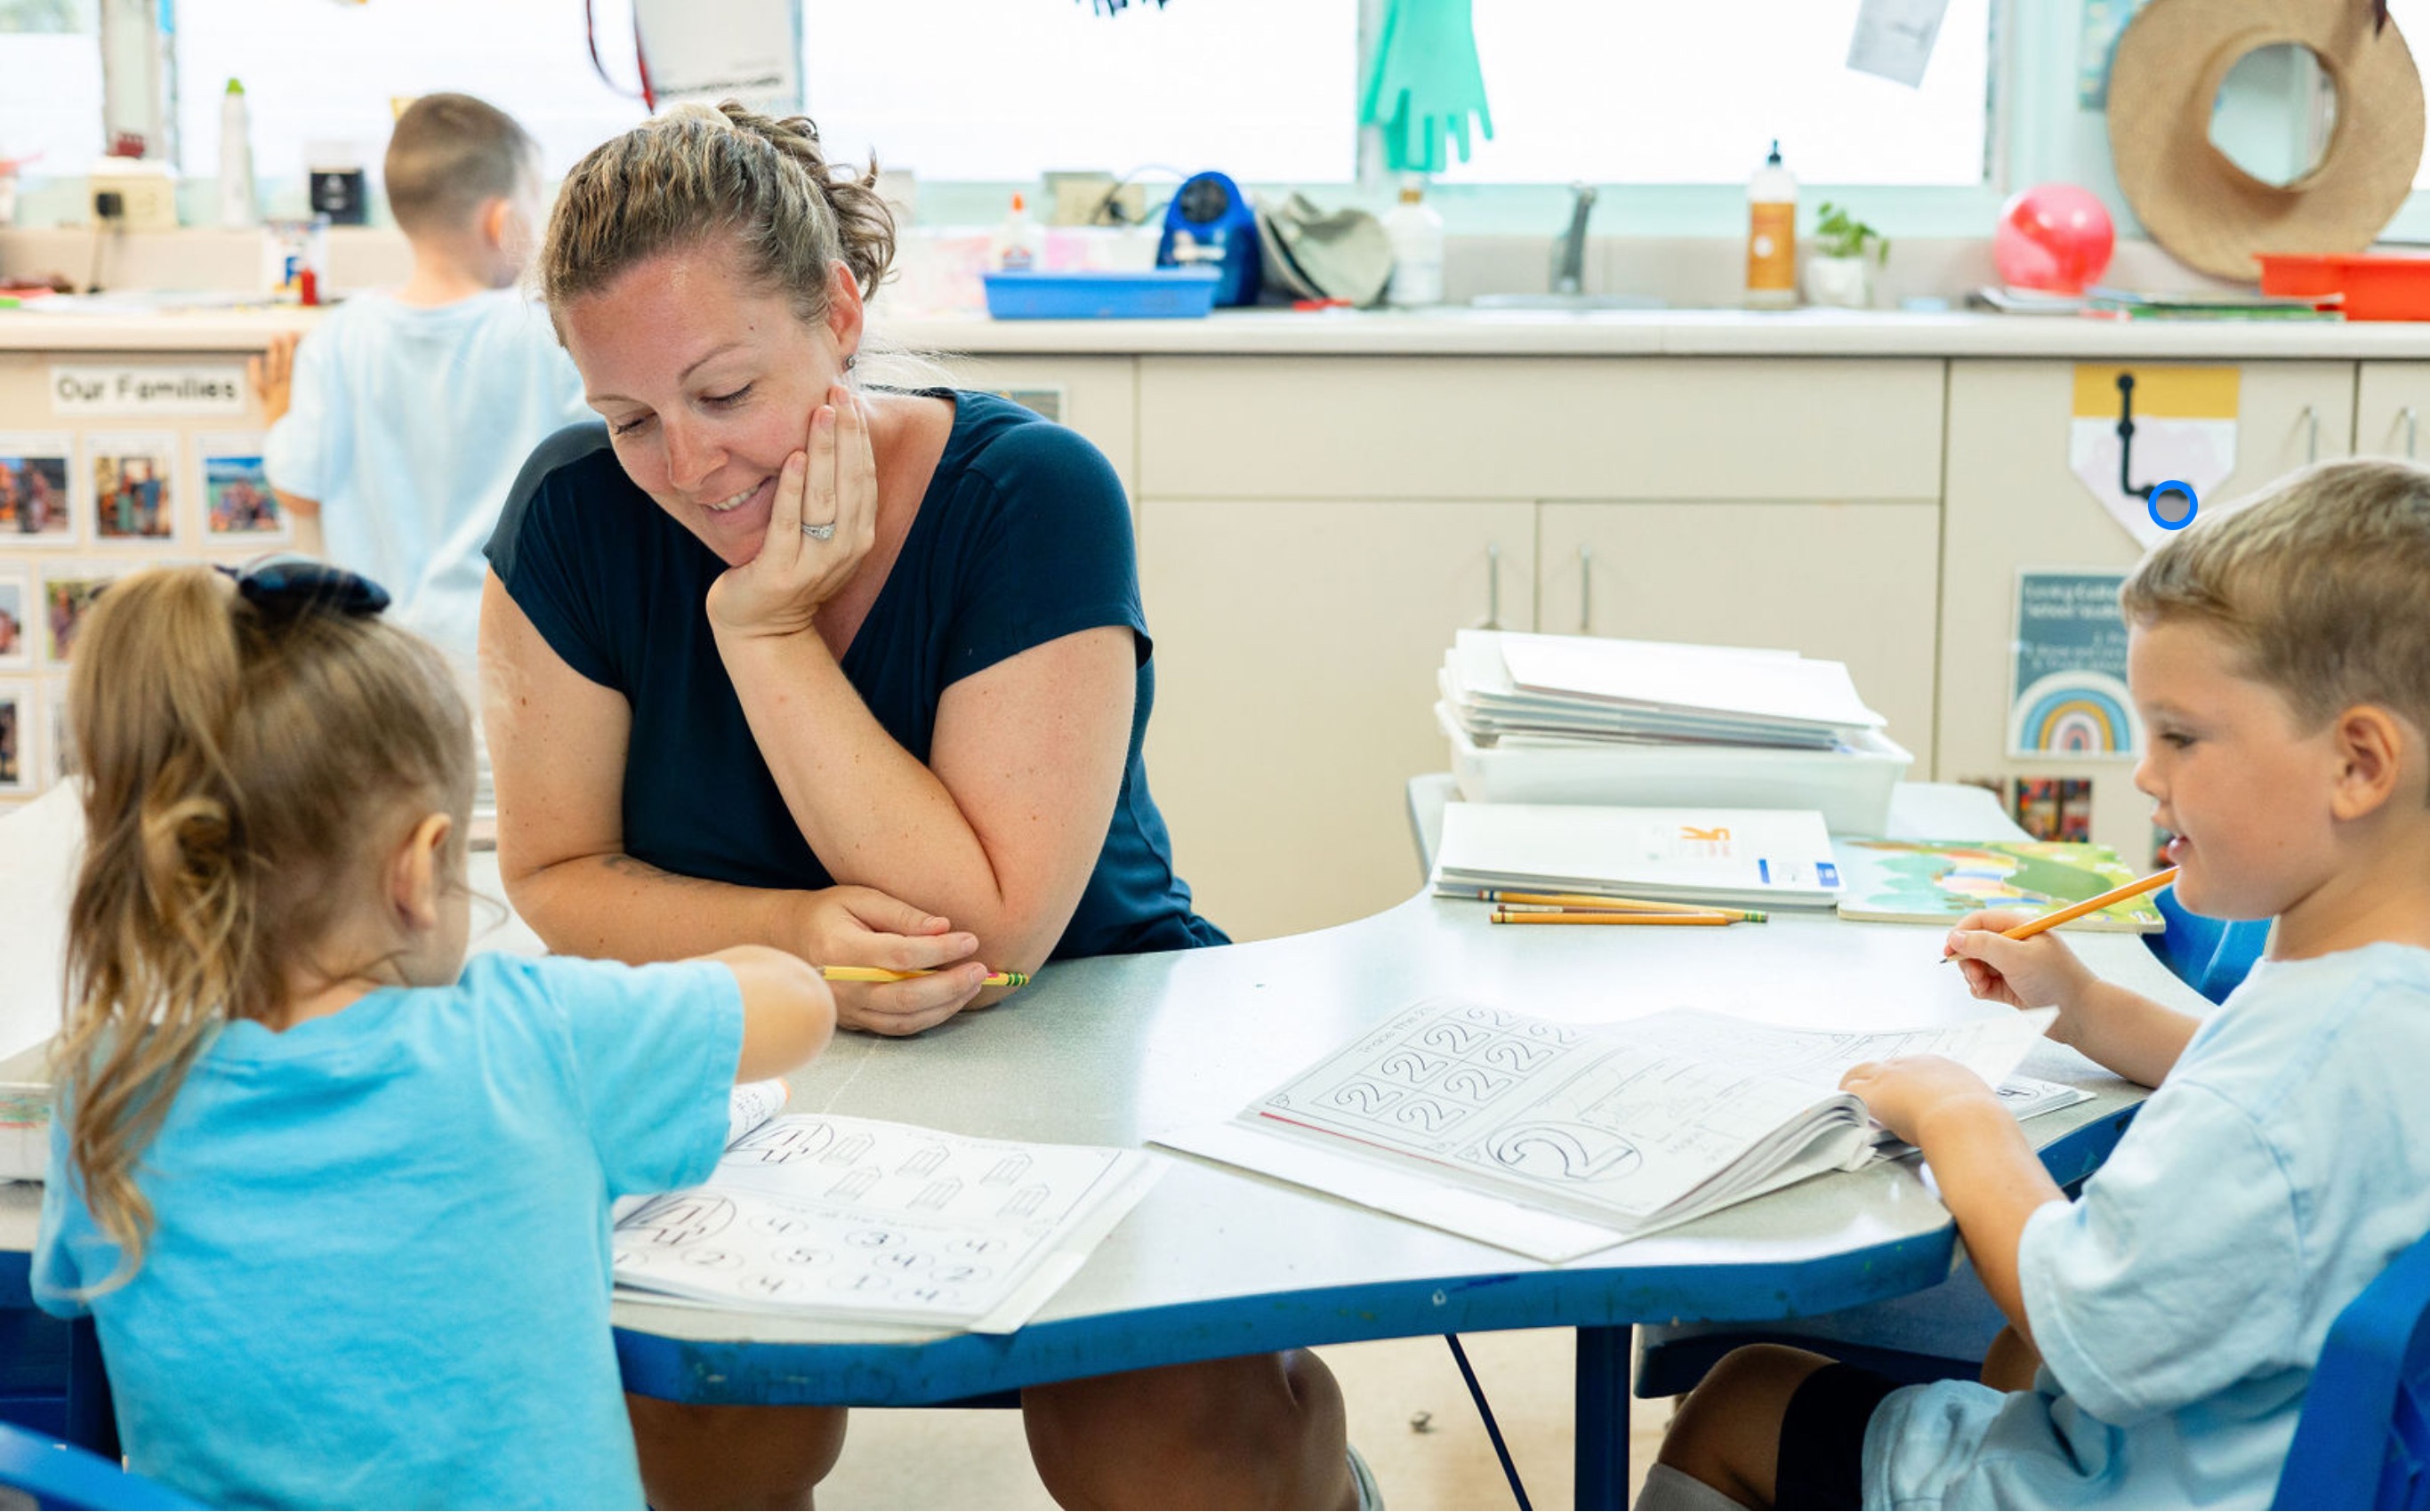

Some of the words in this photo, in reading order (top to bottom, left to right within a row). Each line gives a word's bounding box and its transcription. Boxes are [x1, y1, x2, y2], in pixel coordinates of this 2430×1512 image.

[57, 374, 105, 400] Our
[117, 374, 237, 400] Families
[1334, 1082, 1404, 1113] 2
[1381, 1052, 1449, 1083] 2
[1423, 1023, 1492, 1054] 2
[1396, 1099, 1467, 1132] 2
[1444, 1068, 1513, 1101] 2
[1485, 1040, 1555, 1072] 2
[1497, 1127, 1634, 1180] 2
[768, 1218, 792, 1233] 4
[861, 1232, 889, 1245] 3
[965, 1240, 989, 1252] 4
[696, 1251, 727, 1265] 2
[892, 1254, 917, 1267] 4
[947, 1267, 975, 1281] 2
[759, 1276, 785, 1293] 4
[913, 1289, 940, 1301] 4
